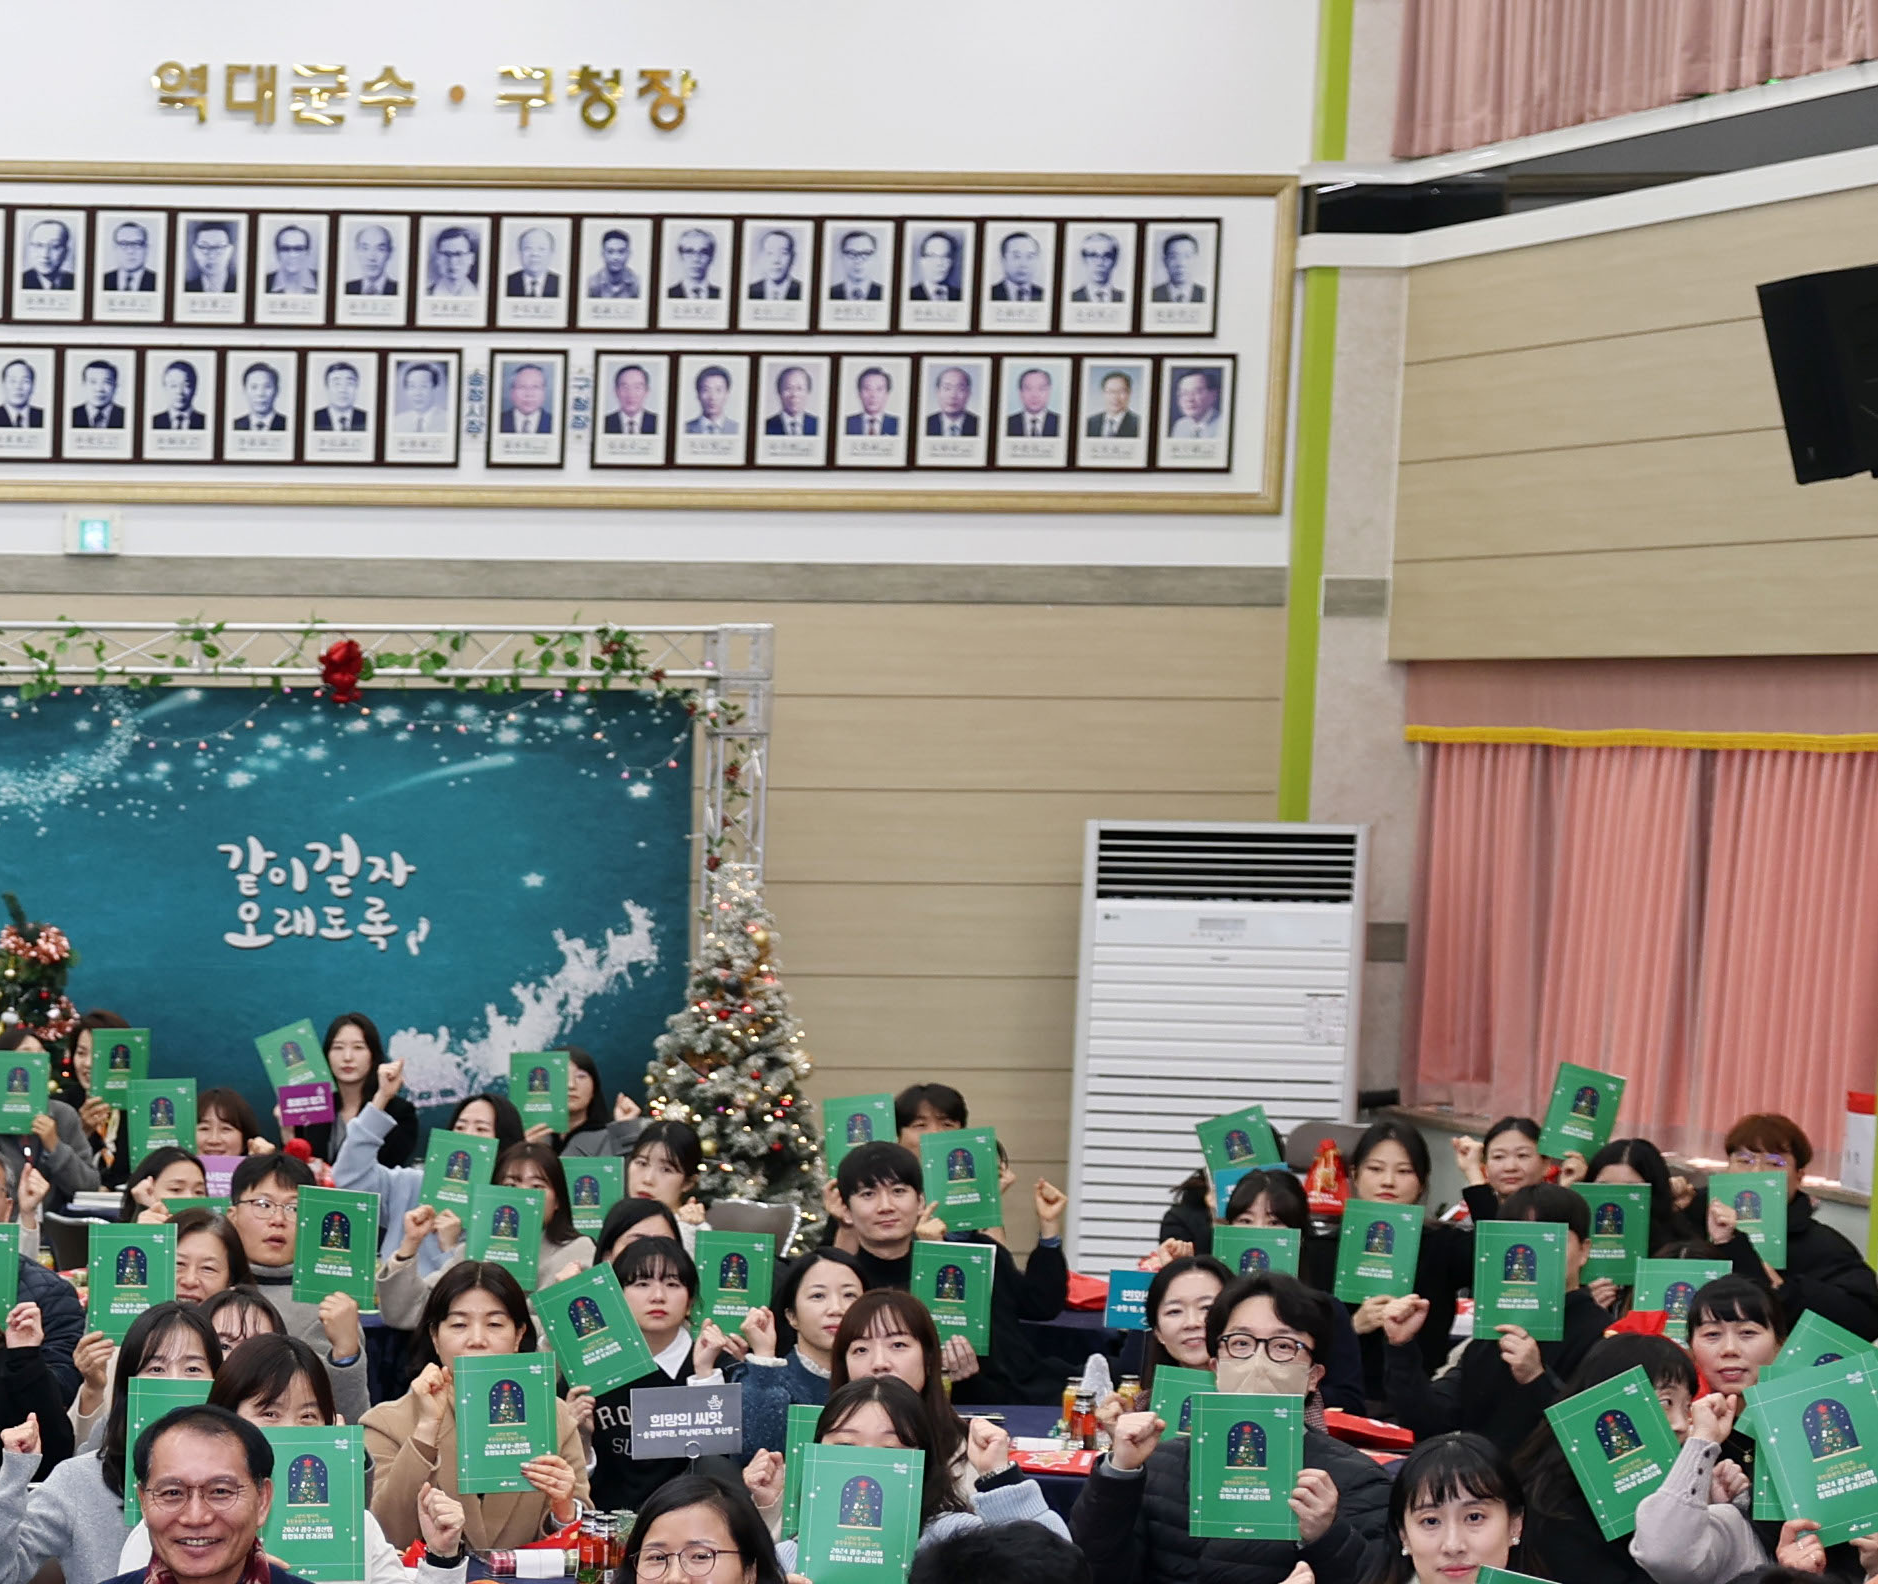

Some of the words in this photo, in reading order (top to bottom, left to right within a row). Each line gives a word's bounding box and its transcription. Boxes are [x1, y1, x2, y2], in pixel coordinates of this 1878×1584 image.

[224, 901, 400, 952] 오래도록
[649, 1413, 692, 1428] 희망의
[694, 1411, 724, 1425] 씨앗
